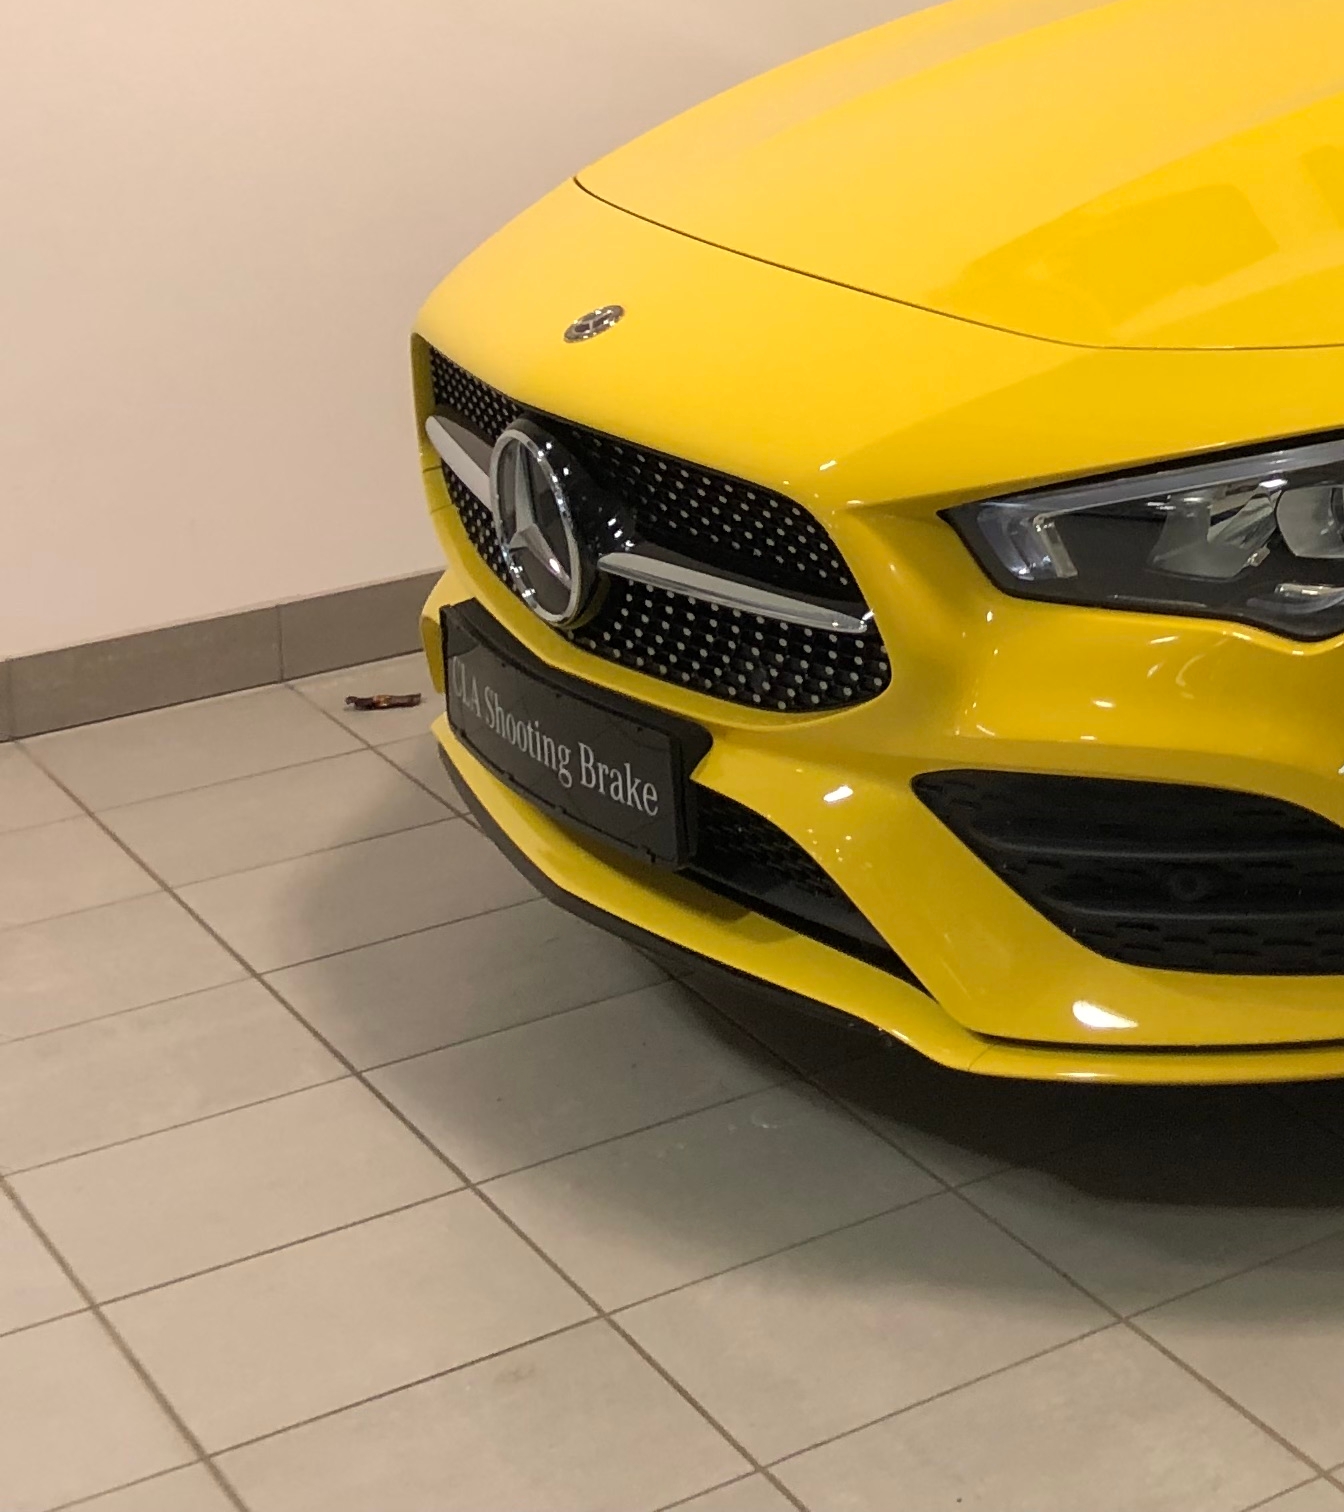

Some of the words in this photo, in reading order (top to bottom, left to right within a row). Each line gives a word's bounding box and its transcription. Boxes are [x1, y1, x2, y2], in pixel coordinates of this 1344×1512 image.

[451, 655, 483, 719] CLA
[484, 687, 574, 789] Shooting
[577, 742, 659, 816] Brake
